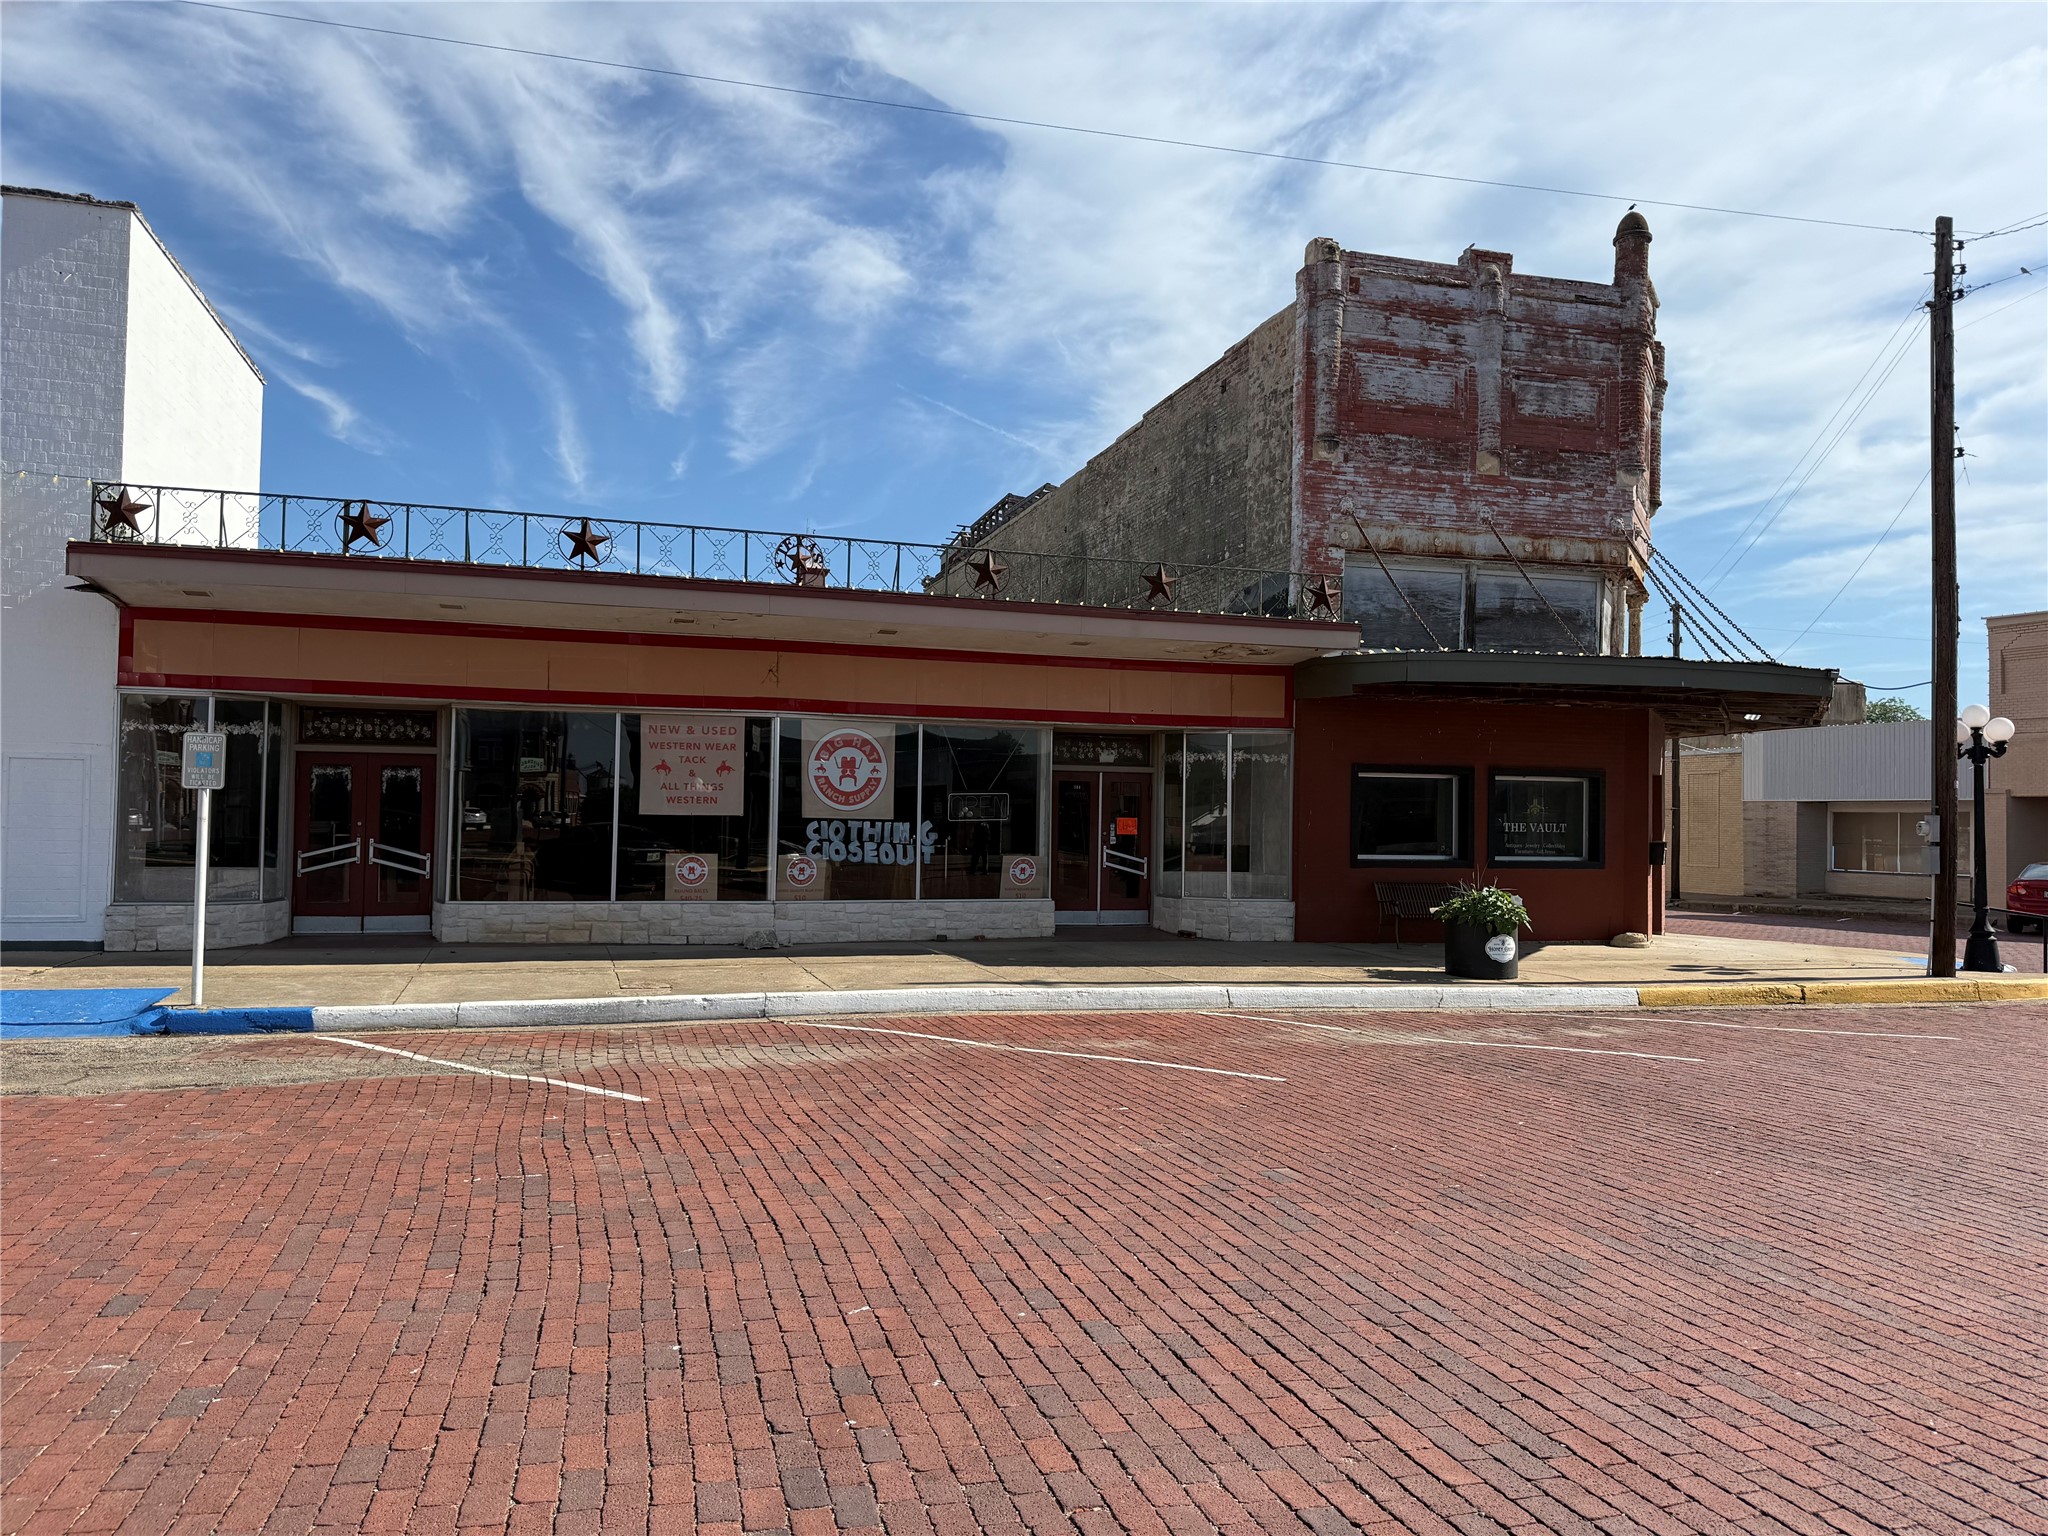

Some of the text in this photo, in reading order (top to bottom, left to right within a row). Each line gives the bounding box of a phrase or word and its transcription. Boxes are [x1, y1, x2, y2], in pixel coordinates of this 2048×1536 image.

[648, 725, 737, 736] NEW & USED
[187, 735, 222, 743] HANDICAP
[648, 742, 737, 751] WESTERN WEAR
[819, 736, 879, 761] BIG HAT
[678, 756, 707, 764] TACK
[688, 769, 696, 777] &
[660, 782, 724, 791] ALL THINGS
[817, 777, 878, 804] RANCH SUPPLY
[666, 796, 718, 805] WESTERN
[951, 795, 1007, 818] OPEN
[1503, 822, 1568, 833] THE VAULT
